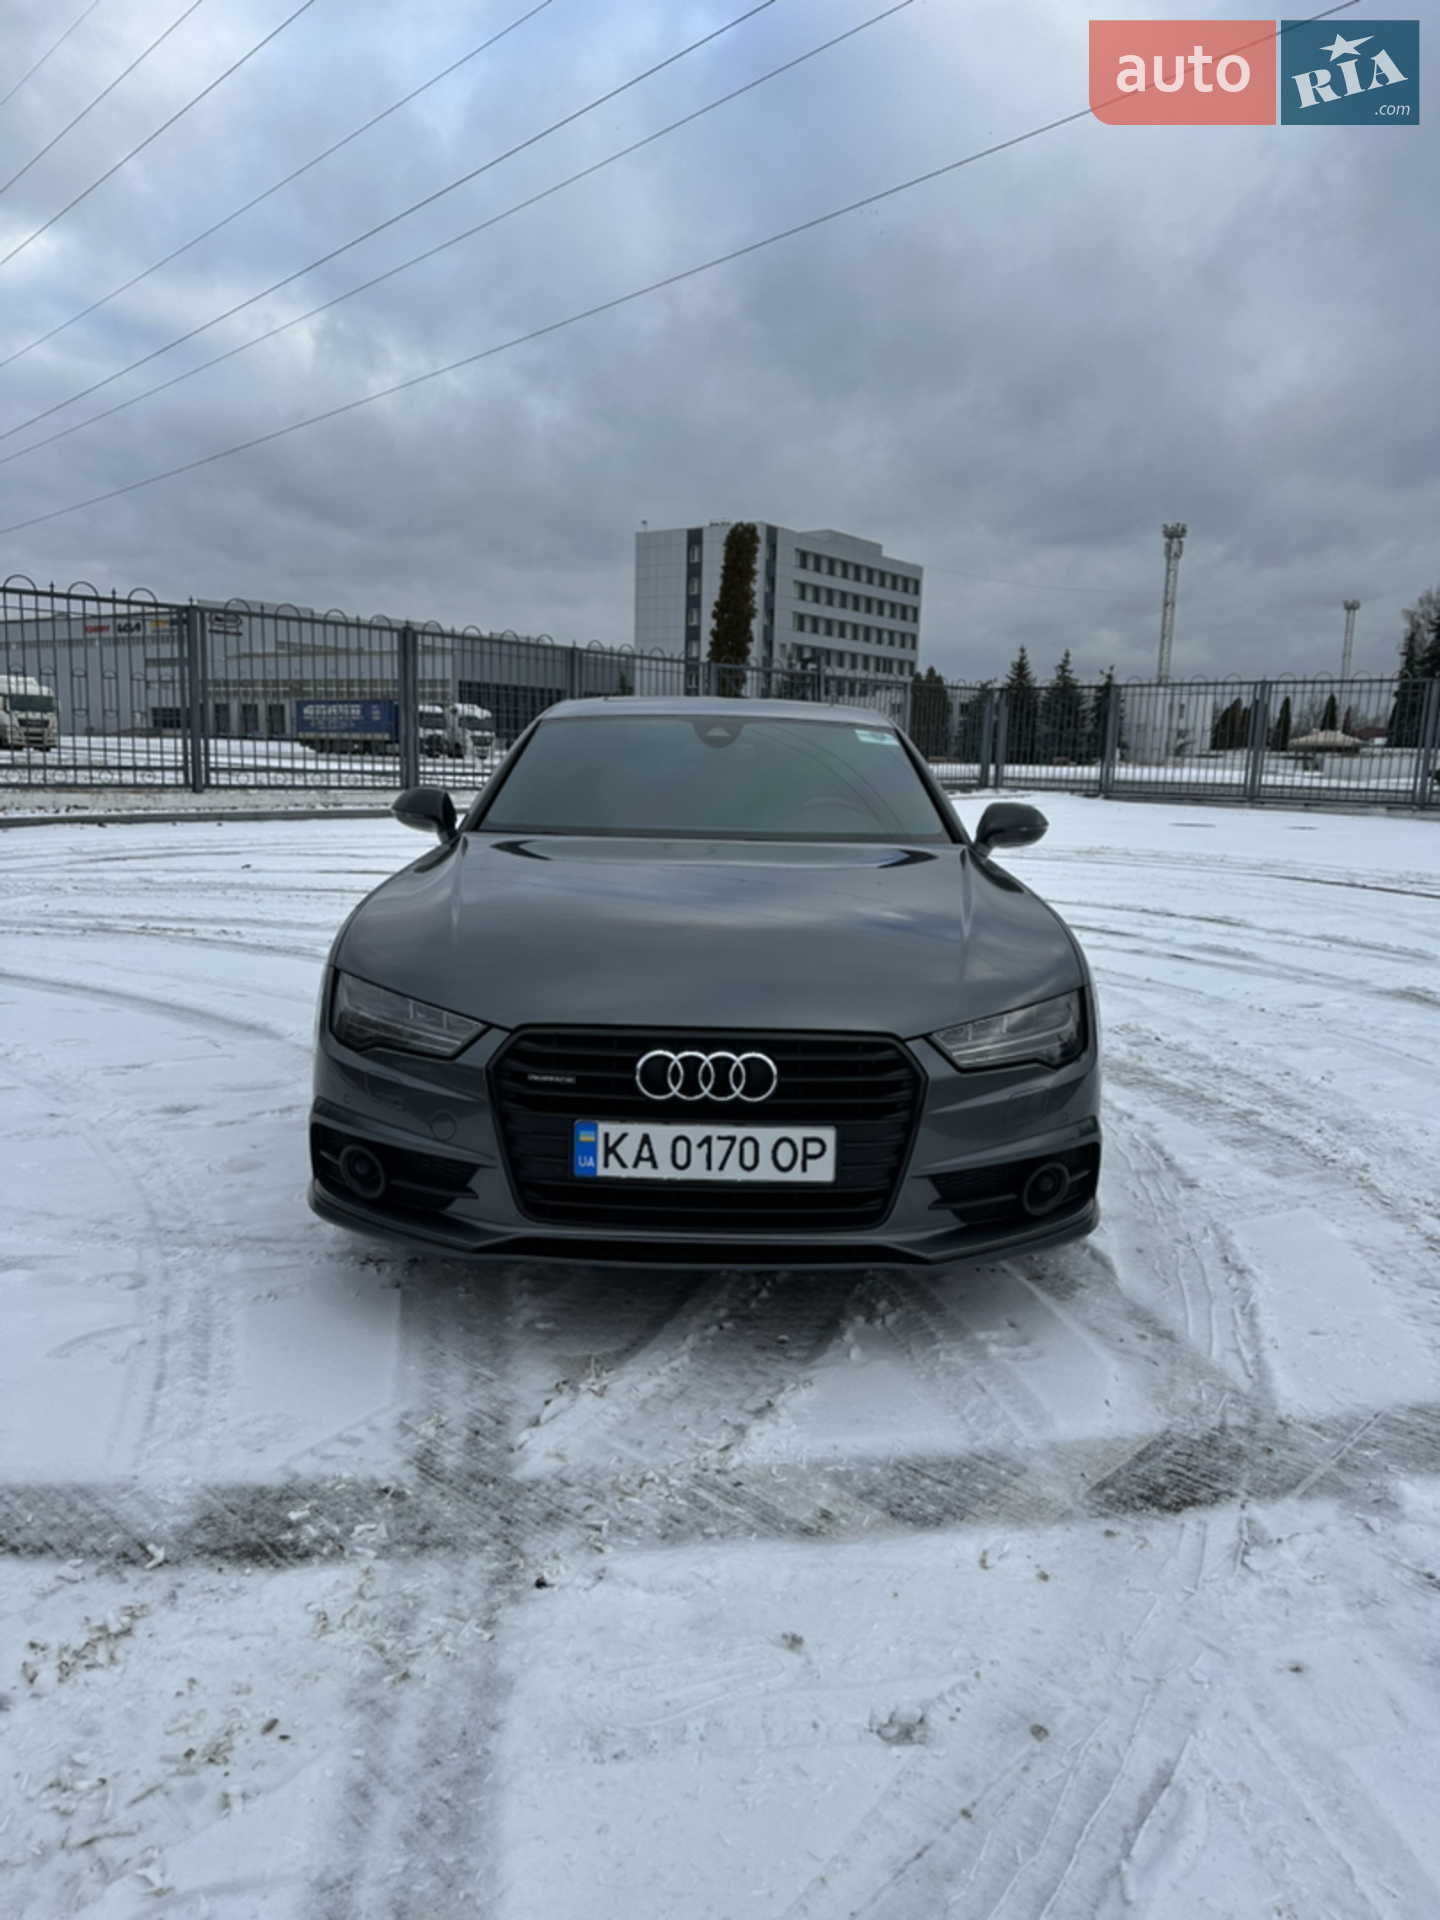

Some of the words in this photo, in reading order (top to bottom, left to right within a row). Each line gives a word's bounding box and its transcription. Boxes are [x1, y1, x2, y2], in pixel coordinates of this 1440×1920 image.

[578, 1155, 596, 1168] UA
[603, 1132, 659, 1169] KA
[670, 1135, 760, 1172] 0170
[771, 1136, 827, 1173] OP
